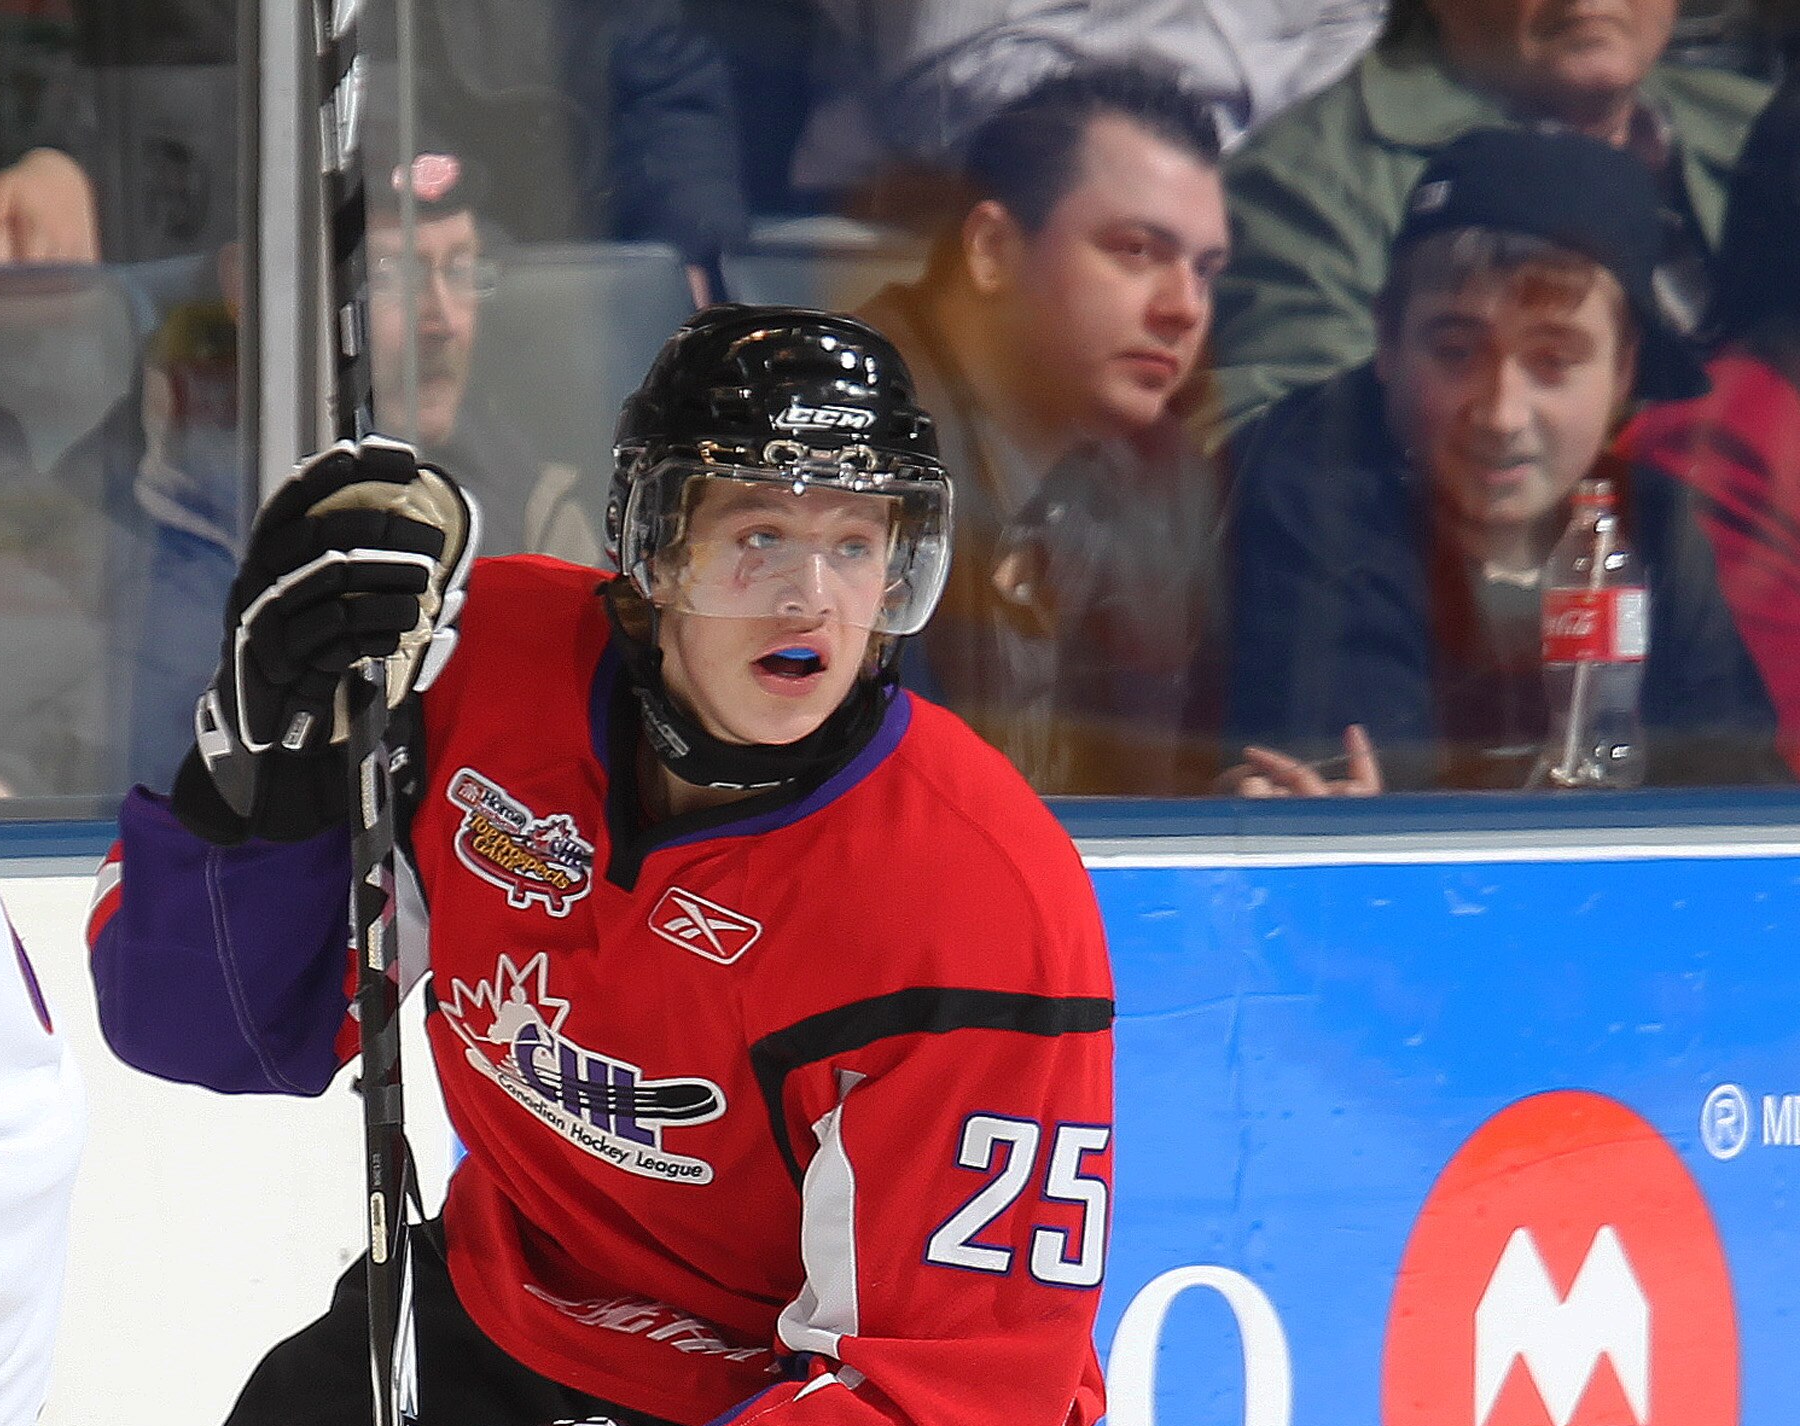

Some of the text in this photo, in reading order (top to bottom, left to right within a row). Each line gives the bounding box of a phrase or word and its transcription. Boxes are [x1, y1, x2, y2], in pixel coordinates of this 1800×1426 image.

[781, 406, 872, 429] CCM
[473, 835, 517, 872] GAME
[493, 831, 572, 890] Prospects
[498, 1072, 703, 1180] Canadian Hockey League
[514, 1022, 657, 1150] CHL
[922, 1112, 1113, 1289] 25
